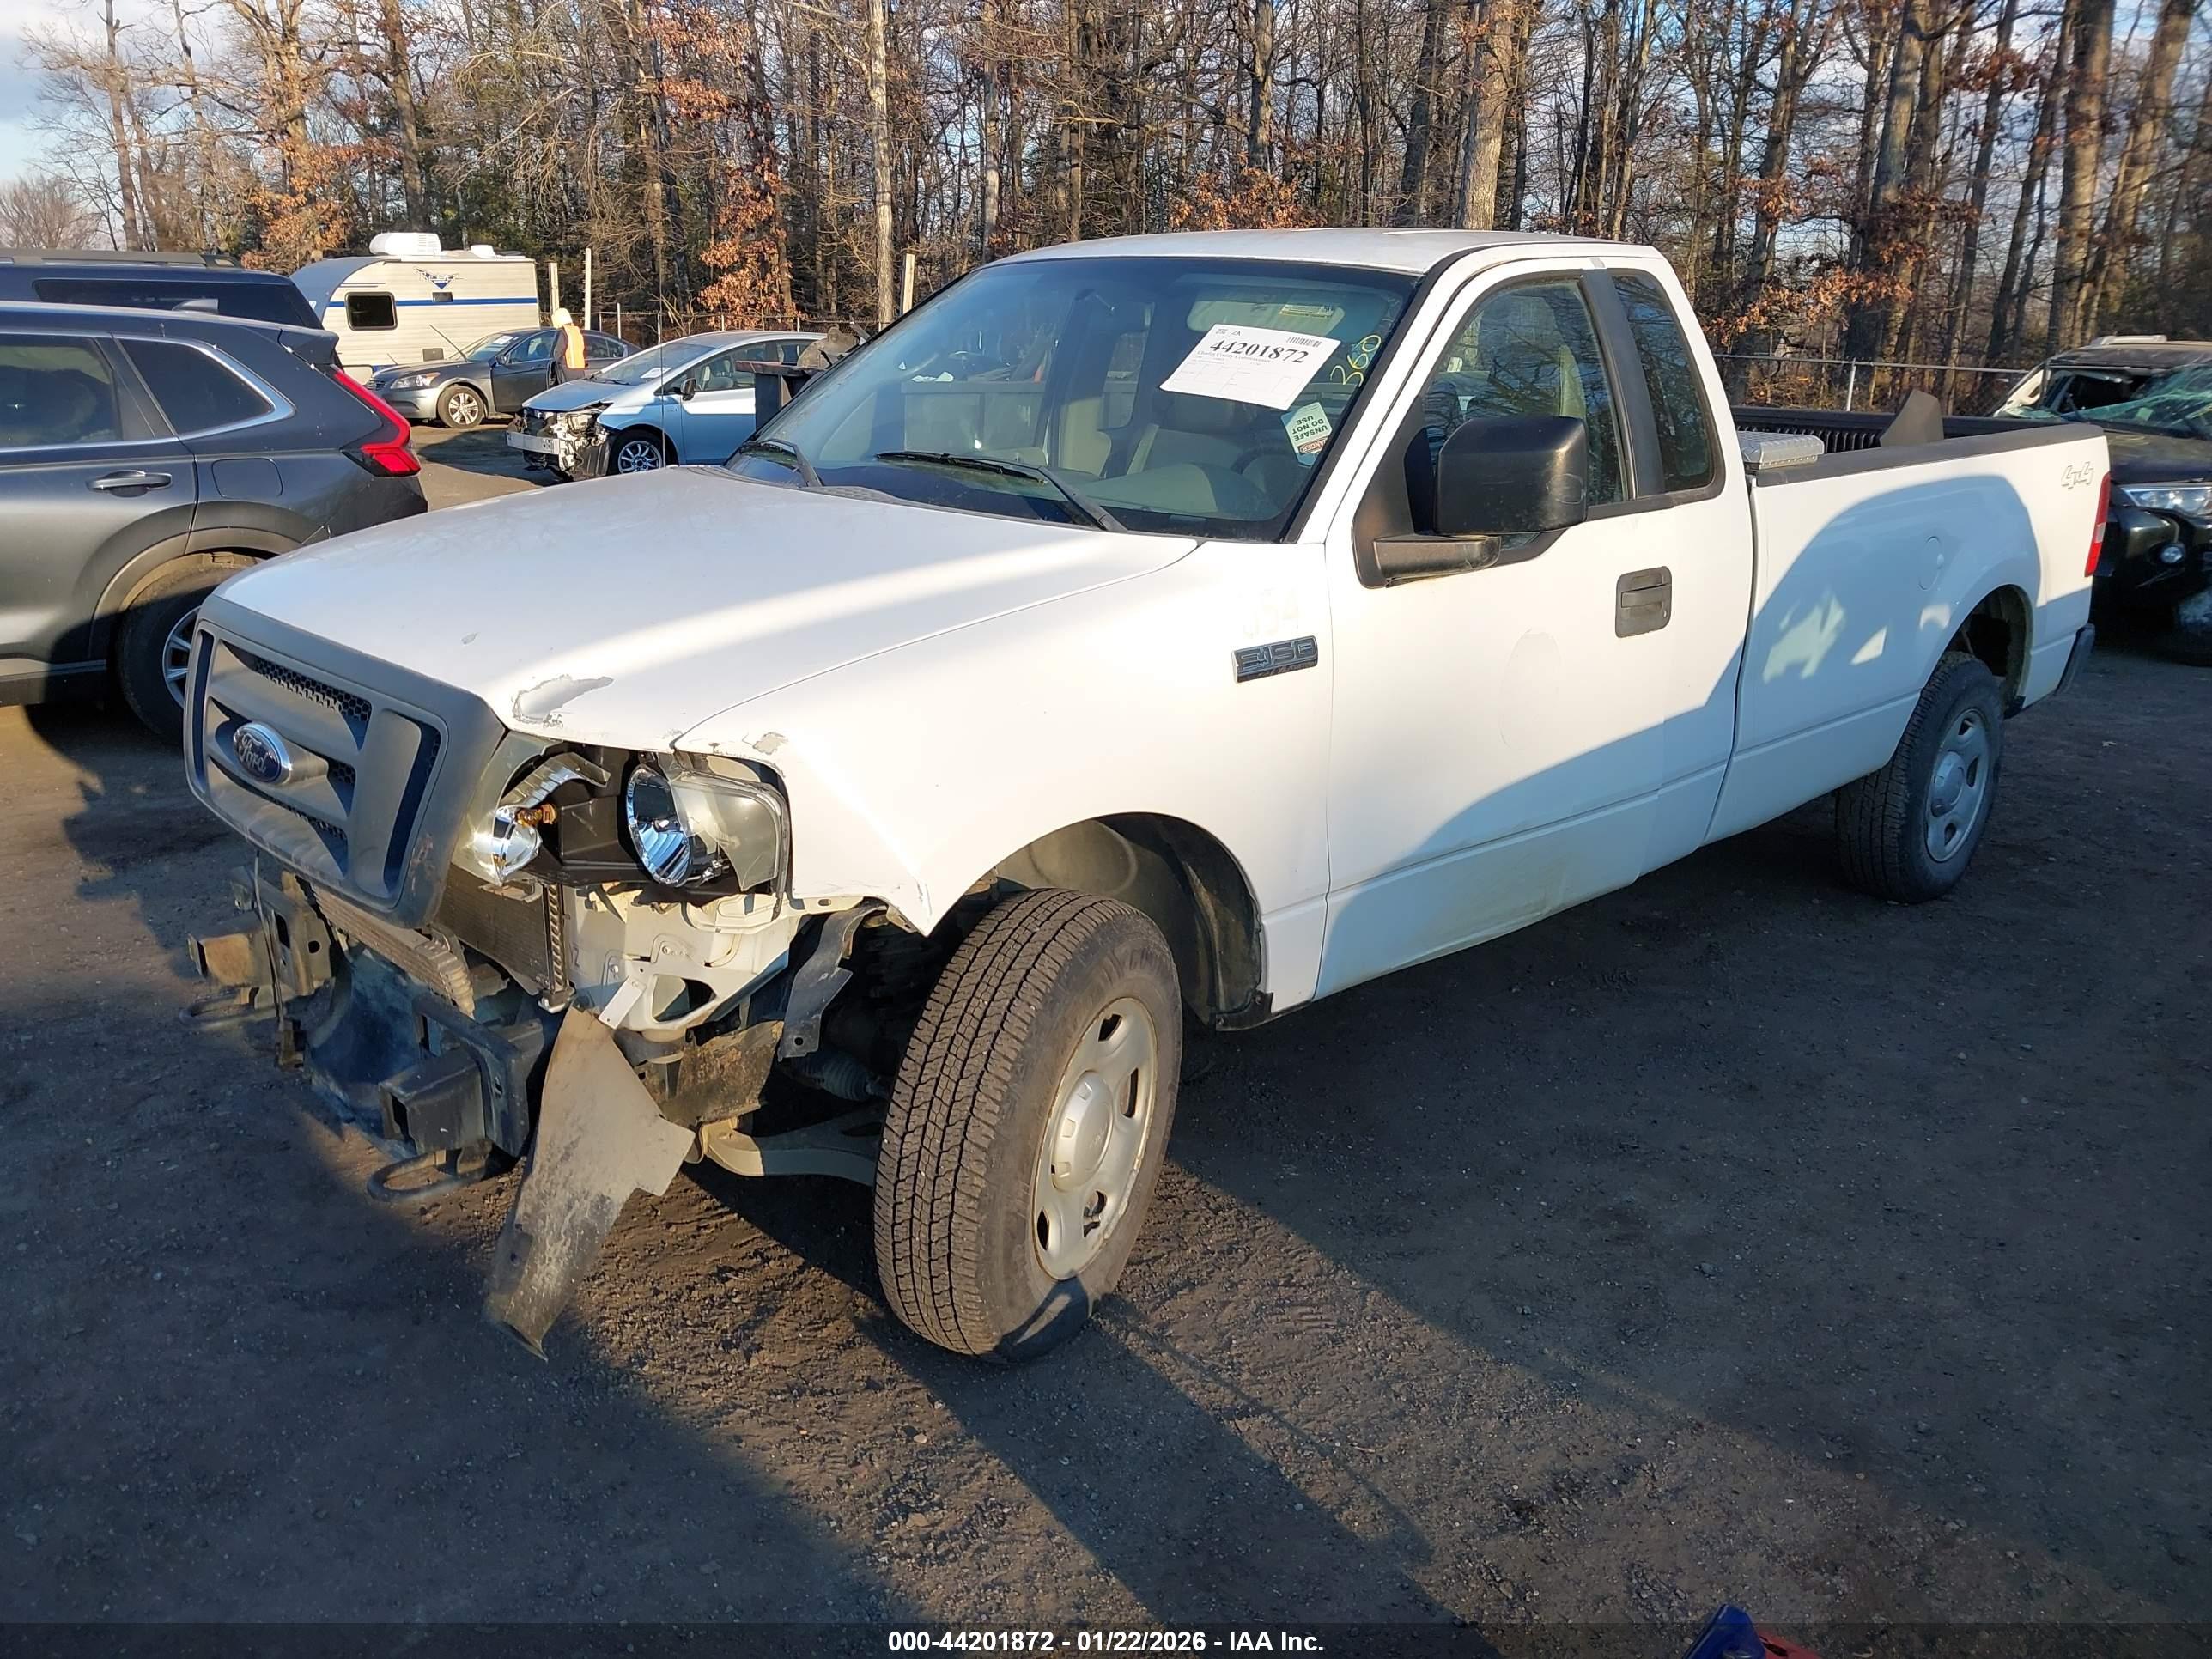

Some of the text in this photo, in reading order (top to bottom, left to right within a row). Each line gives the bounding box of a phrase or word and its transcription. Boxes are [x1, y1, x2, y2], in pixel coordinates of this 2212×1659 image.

[1209, 339, 1309, 363] 44201872
[1329, 334, 1382, 388] 360
[1291, 418, 1324, 434] DO NOT
[1297, 415, 1315, 426] USE
[1293, 425, 1328, 441] UNSAFE
[240, 732, 267, 774] Ford
